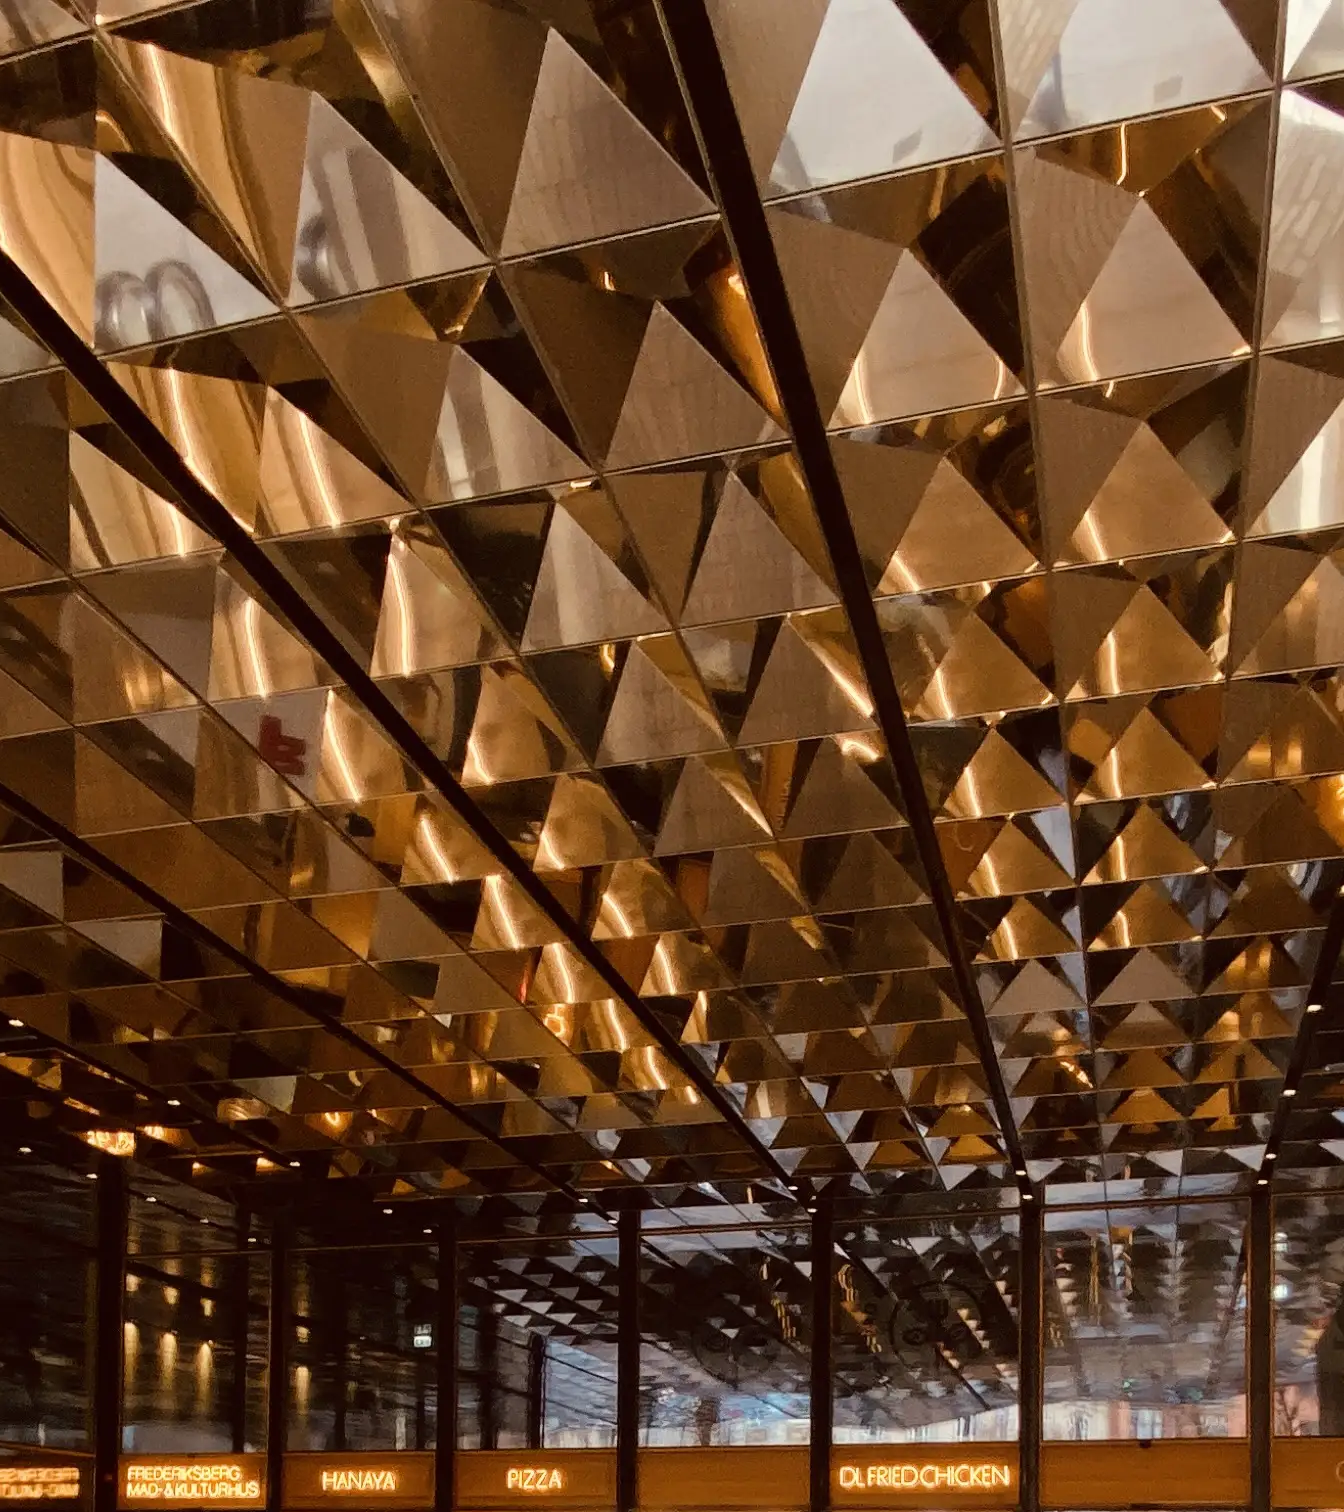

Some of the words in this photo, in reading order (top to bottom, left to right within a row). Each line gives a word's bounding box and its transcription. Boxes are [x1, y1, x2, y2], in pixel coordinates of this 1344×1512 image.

[127, 1465, 244, 1481] FREDERIKSBERG
[322, 1471, 396, 1491] HANAYA
[507, 1467, 562, 1489] PIZZA
[839, 1466, 865, 1488] DL
[867, 1467, 918, 1487] FRIED
[920, 1464, 1010, 1488] CHICKEN
[177, 1481, 260, 1498] KULTURHUS
